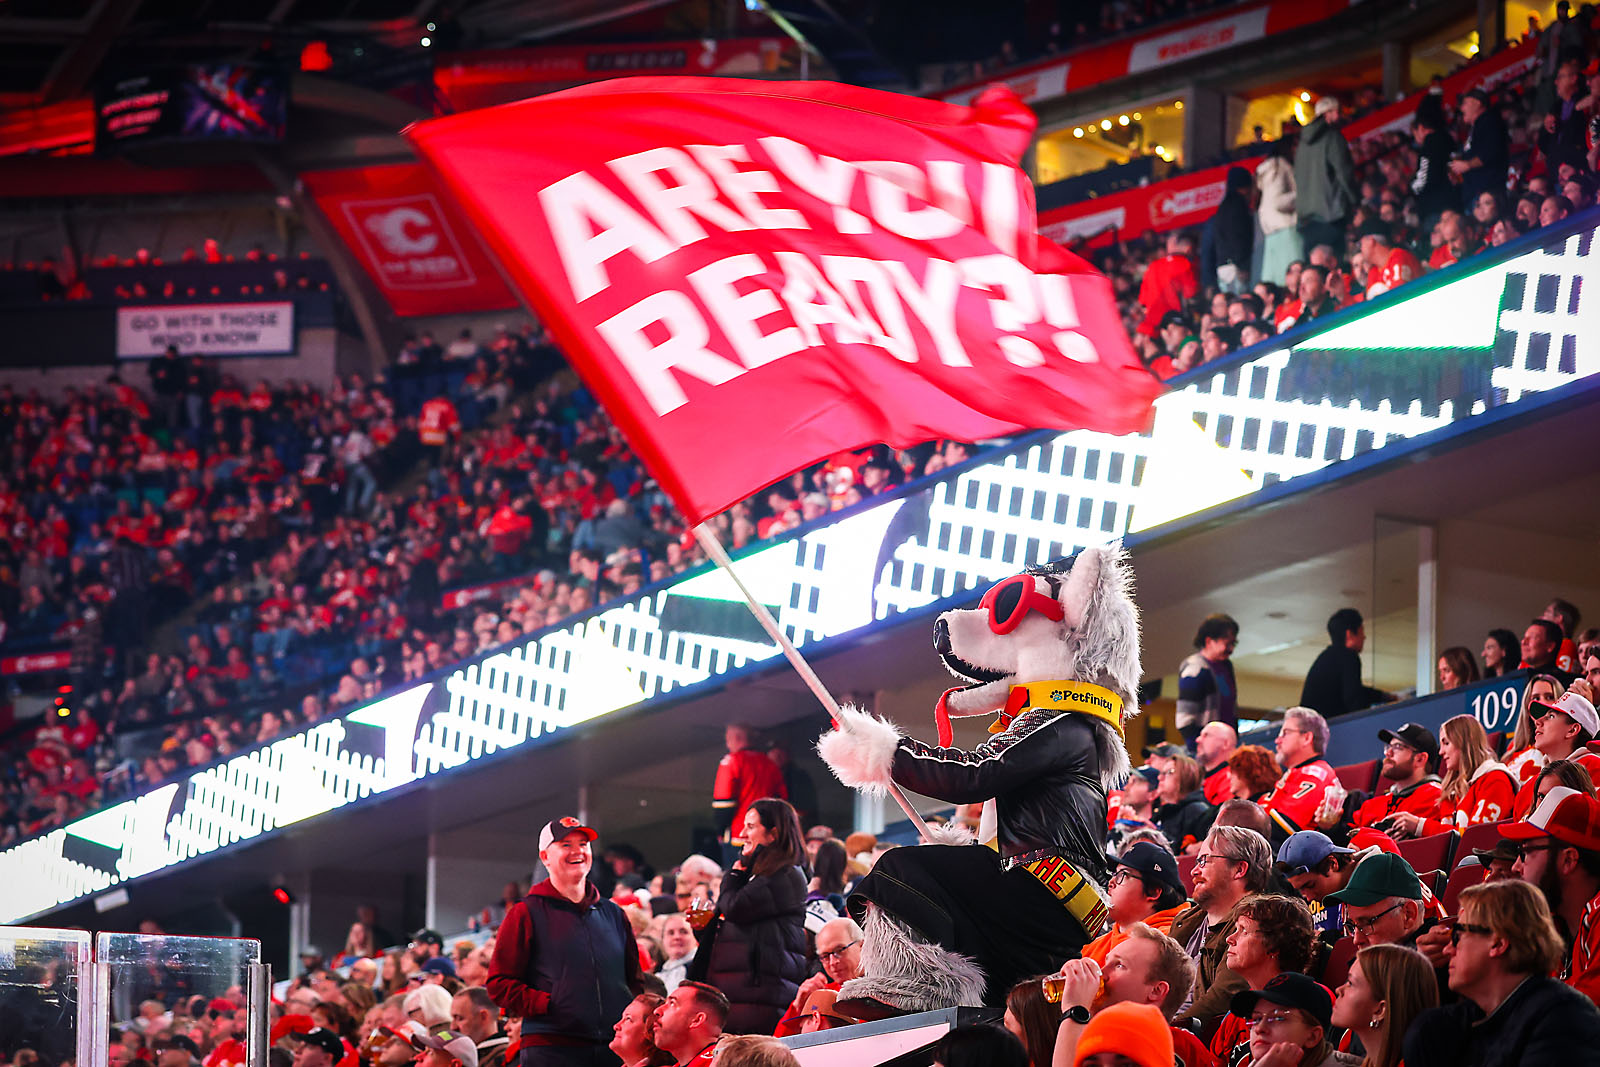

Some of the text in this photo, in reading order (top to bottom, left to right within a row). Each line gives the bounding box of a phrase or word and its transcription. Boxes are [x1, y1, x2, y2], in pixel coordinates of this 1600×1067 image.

[538, 144, 811, 303] ARE
[131, 312, 278, 331] GO WITH THOSE
[596, 251, 1100, 417] READY?!
[201, 331, 260, 345] KNOW
[1063, 690, 1113, 713] Petfinity
[1471, 687, 1518, 729] 109
[1471, 799, 1501, 823] 13
[1024, 857, 1076, 895] HE
